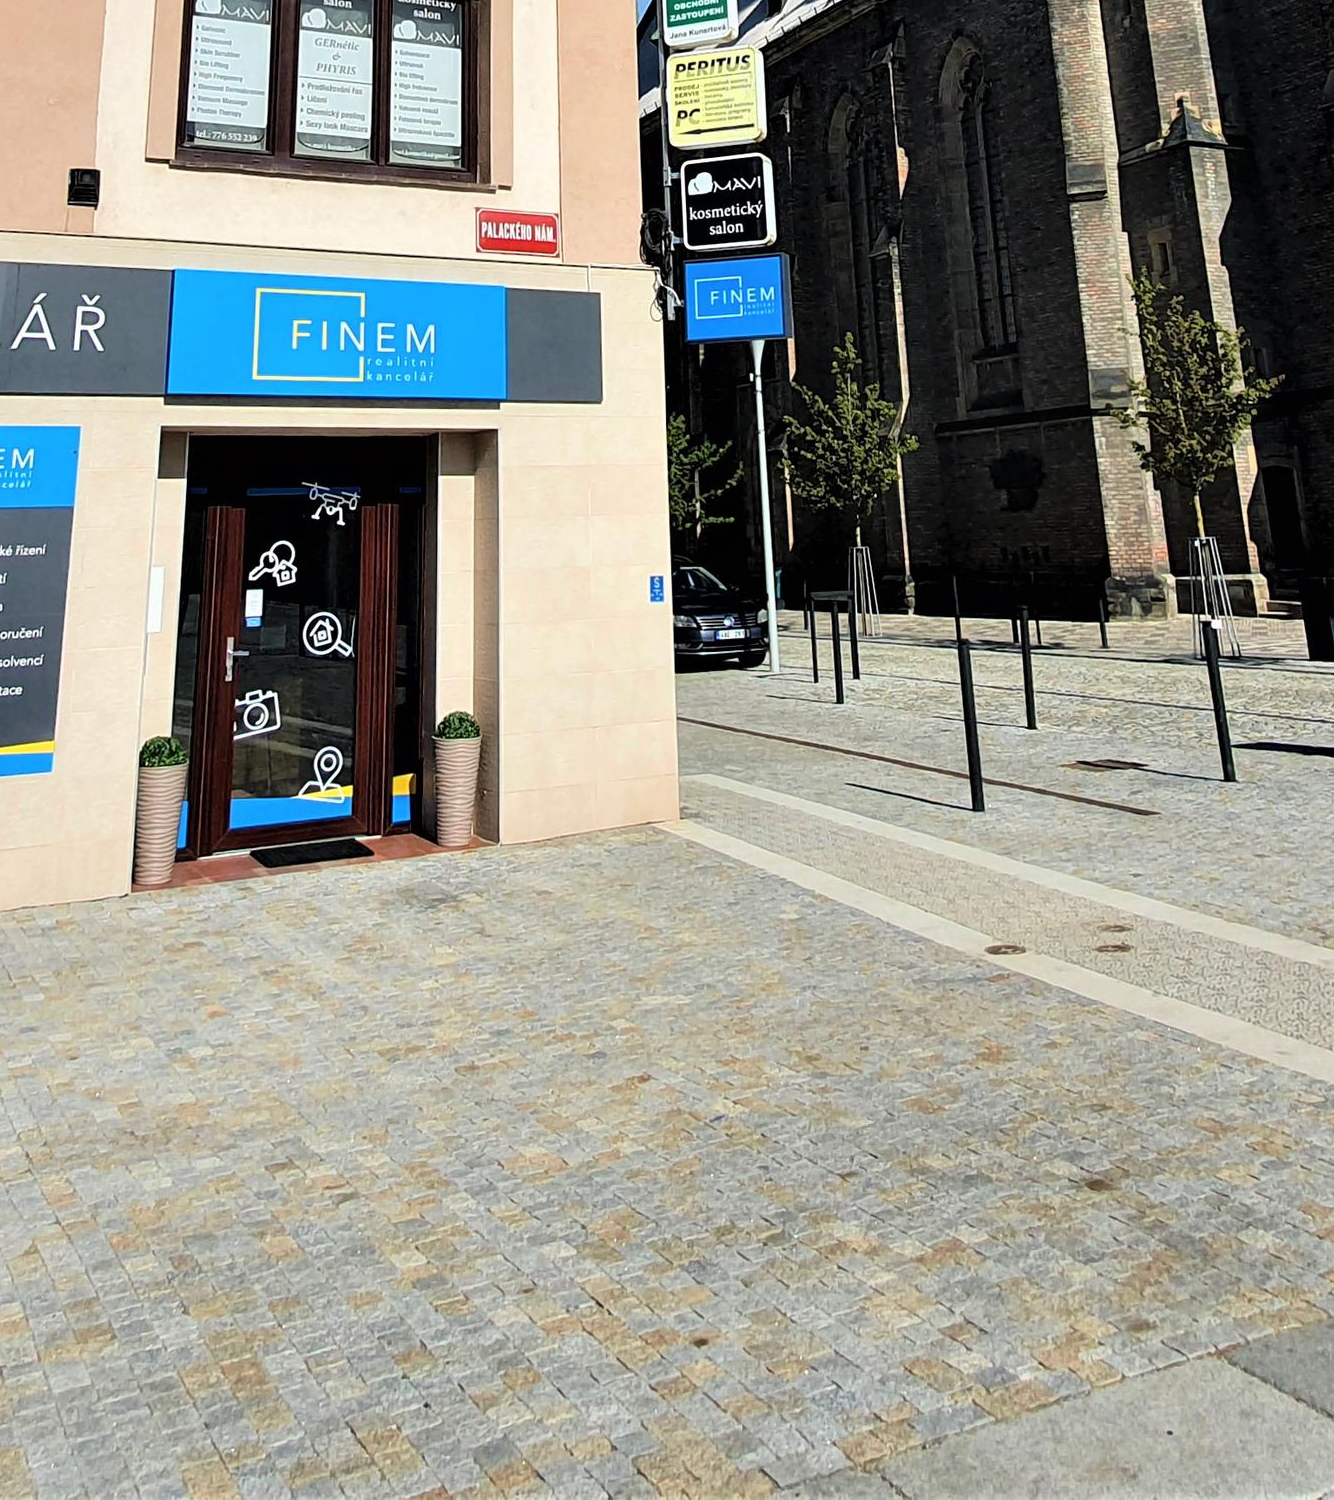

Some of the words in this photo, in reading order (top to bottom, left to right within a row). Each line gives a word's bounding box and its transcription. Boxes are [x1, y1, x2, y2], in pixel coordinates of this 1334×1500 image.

[221, 4, 269, 21] MAVI
[413, 8, 441, 20] salon
[670, 5, 724, 22] ZASTOUPENÍ
[326, 18, 371, 35] MAVI
[670, 31, 687, 39] Jana
[417, 29, 459, 45] MAVI
[316, 62, 356, 75] PHYRIS
[674, 55, 751, 79] PERITUS
[674, 84, 699, 92] PRODEJ
[676, 108, 700, 127] PC
[713, 176, 762, 193] MAVI
[689, 200, 763, 220] kosmetický
[481, 221, 532, 241] PALACKÉHO
[535, 223, 556, 243] NÁM.
[709, 220, 744, 235] salon
[710, 286, 775, 306] FINEM
[291, 319, 437, 354] FINEM
[367, 355, 435, 369] realitní
[366, 369, 435, 383] kancelář
[15, 543, 47, 556] řízení
